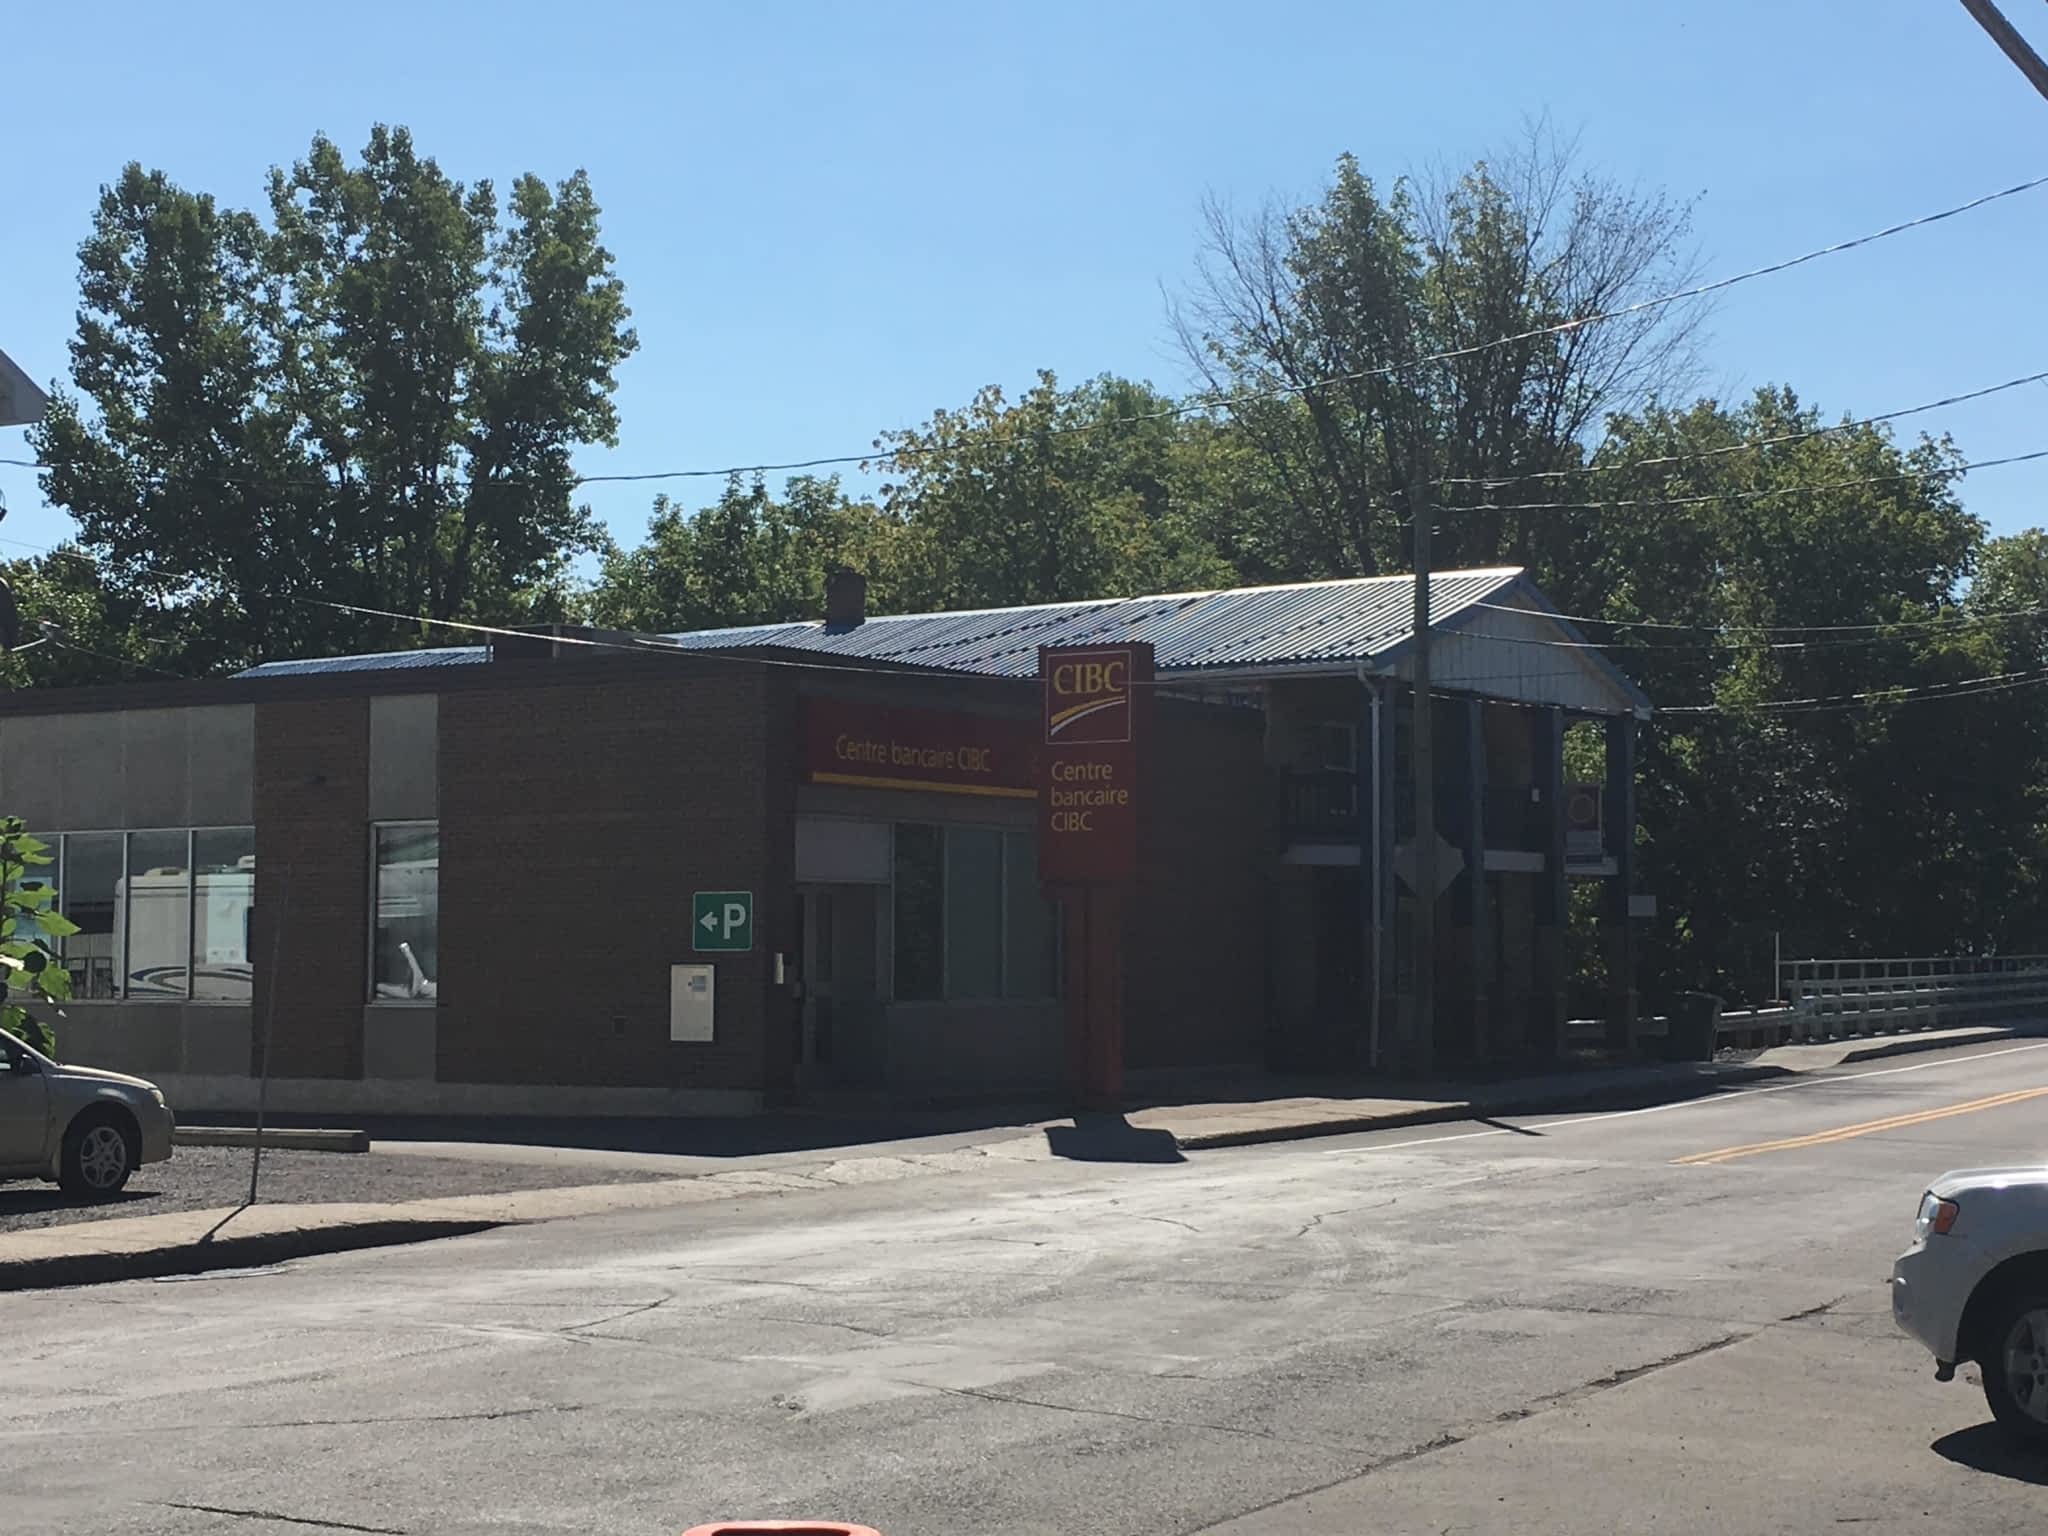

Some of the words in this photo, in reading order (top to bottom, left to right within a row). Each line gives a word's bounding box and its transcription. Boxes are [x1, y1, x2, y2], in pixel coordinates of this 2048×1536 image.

[1054, 662, 1124, 694] CIBC
[836, 734, 888, 765] Centre
[958, 746, 993, 773] CIBC
[1051, 761, 1113, 781] Centre
[1051, 784, 1129, 806] bancaire
[1051, 811, 1093, 831] CIBC
[723, 903, 747, 940] P
